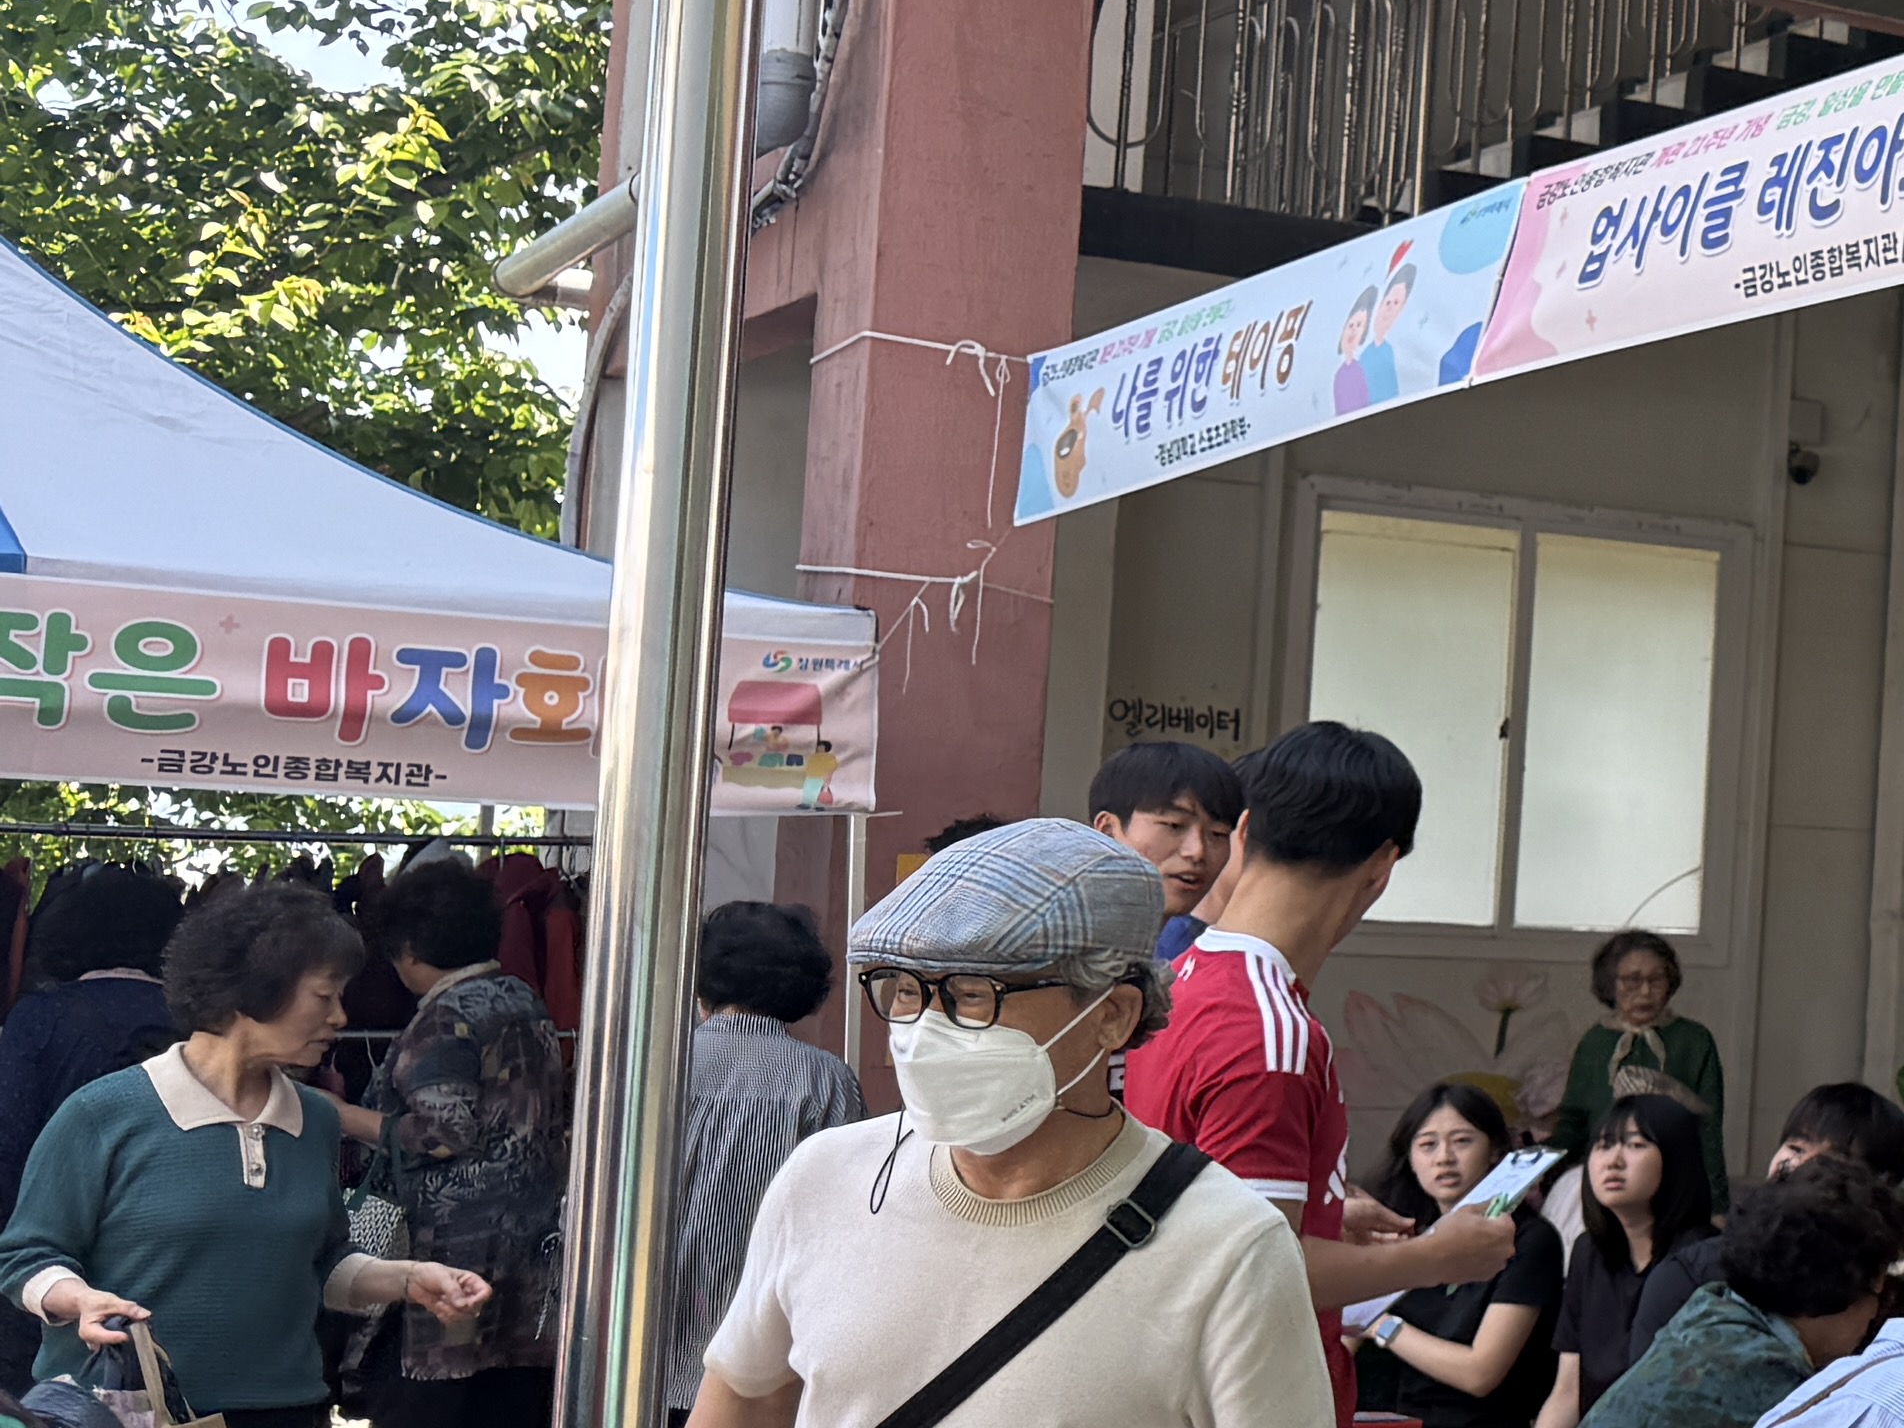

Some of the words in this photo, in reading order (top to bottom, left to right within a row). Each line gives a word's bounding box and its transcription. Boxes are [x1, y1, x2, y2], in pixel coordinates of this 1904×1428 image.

[1577, 159, 1750, 285] 업사이클
[1110, 356, 1165, 439] 나를
[1164, 332, 1222, 422] 위한
[1221, 299, 1314, 402] 테이핑
[0, 610, 219, 732] 작은
[1108, 696, 1241, 742] 엘리베이터
